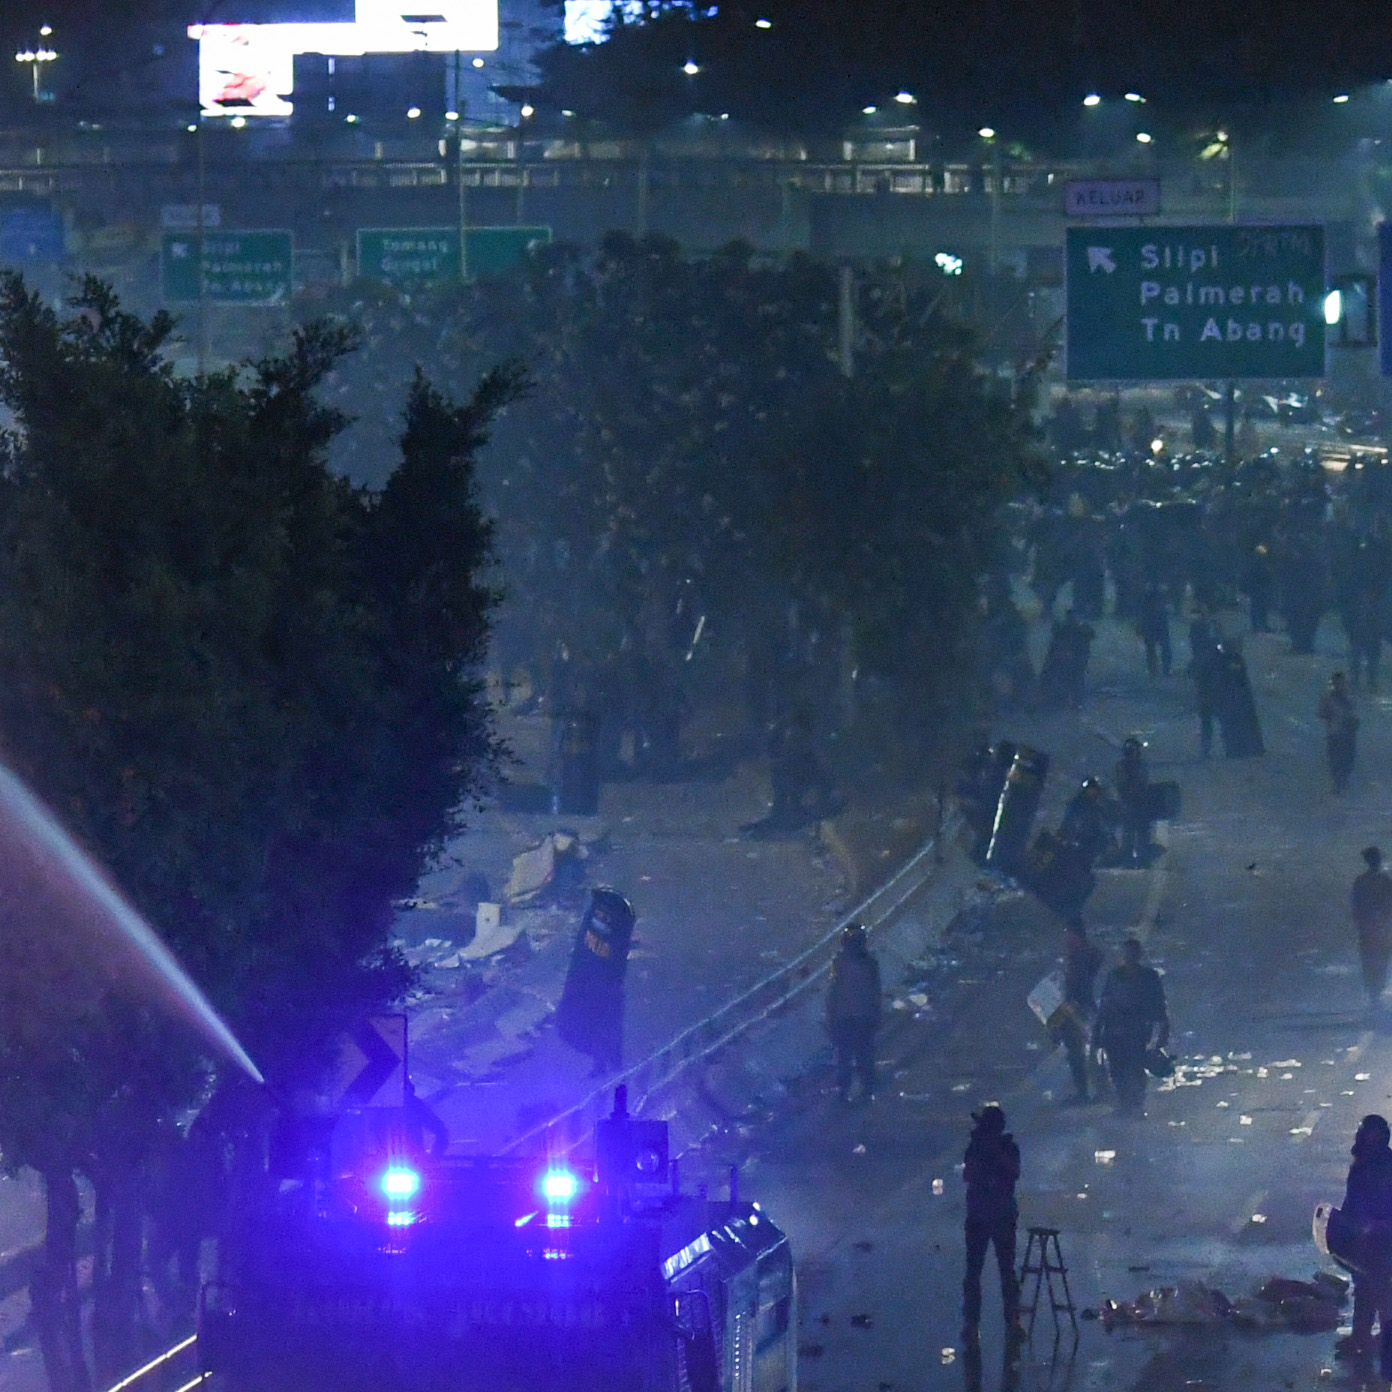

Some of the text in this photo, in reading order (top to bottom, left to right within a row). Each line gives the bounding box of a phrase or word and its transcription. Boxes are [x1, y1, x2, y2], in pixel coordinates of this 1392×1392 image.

[1139, 281, 1305, 305] Palmerah
[1140, 317, 1306, 348] Tn Abang
